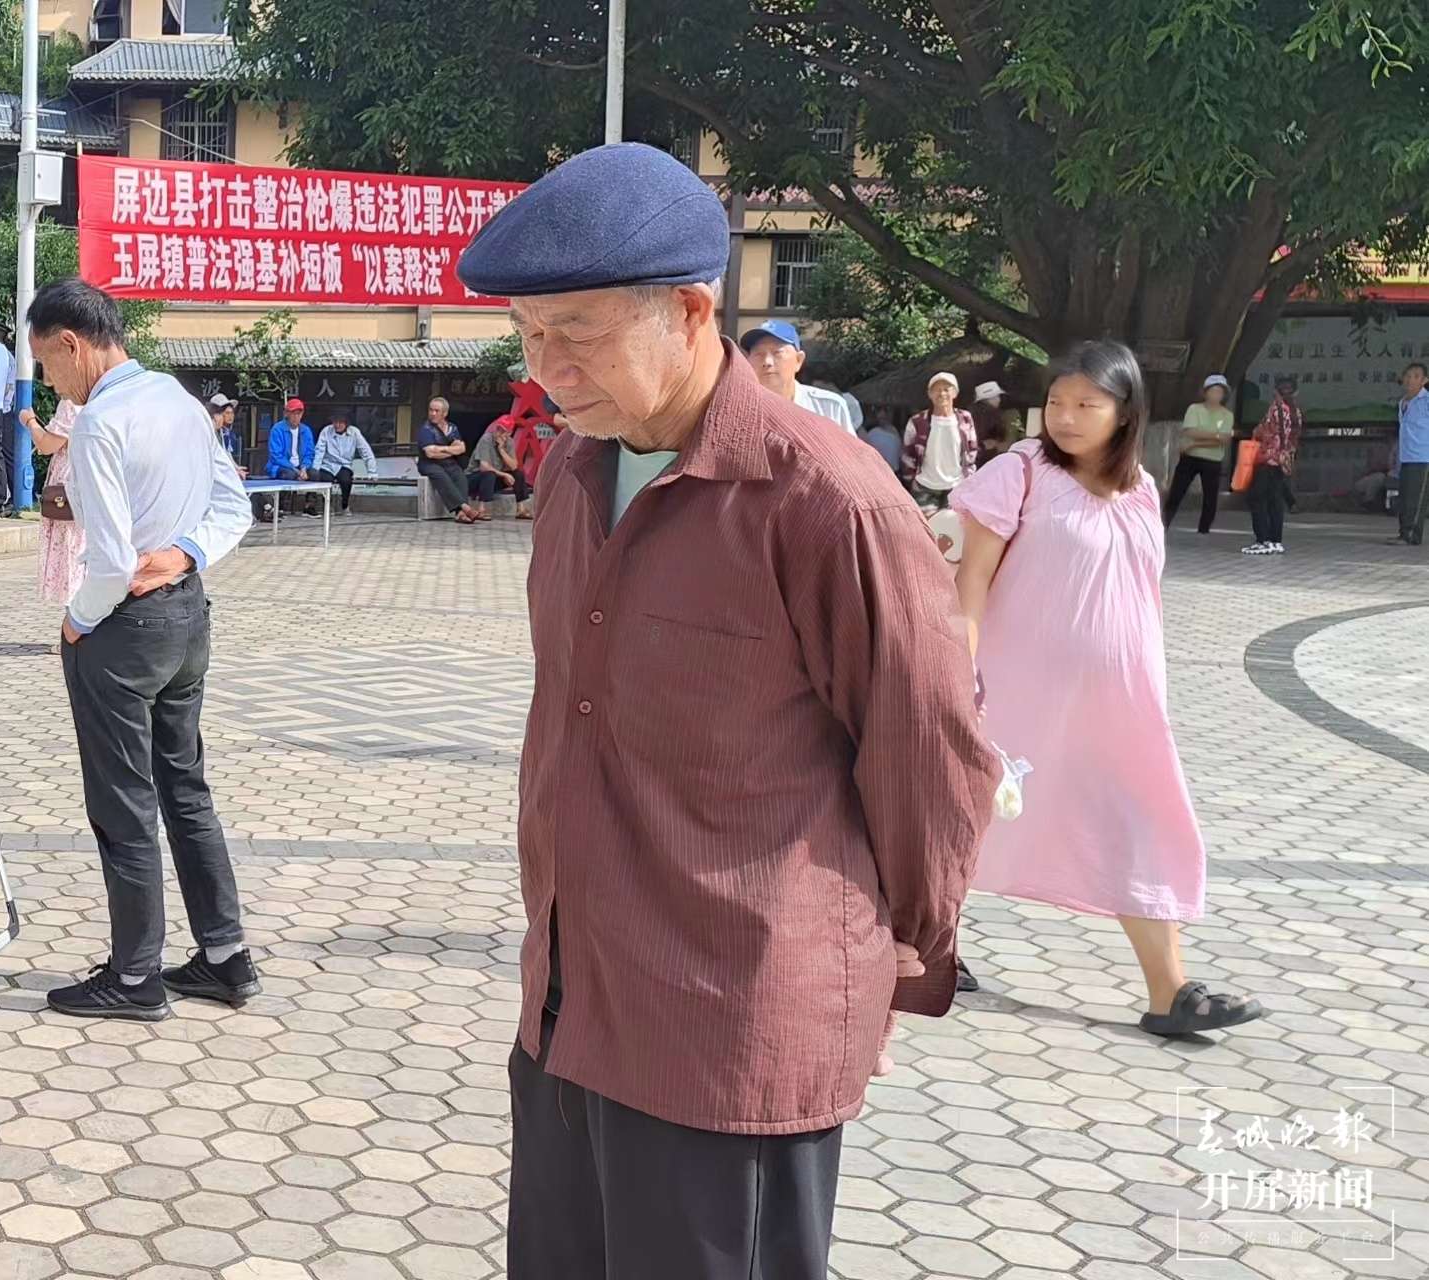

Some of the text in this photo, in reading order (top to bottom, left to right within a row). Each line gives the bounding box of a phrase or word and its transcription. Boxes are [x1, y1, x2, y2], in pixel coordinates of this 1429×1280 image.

[112, 167, 526, 237] 屏边县打击整治枪爆违法犯罪公开
[111, 233, 509, 297] 玉屏镇普法强基补短板“以案释法”
